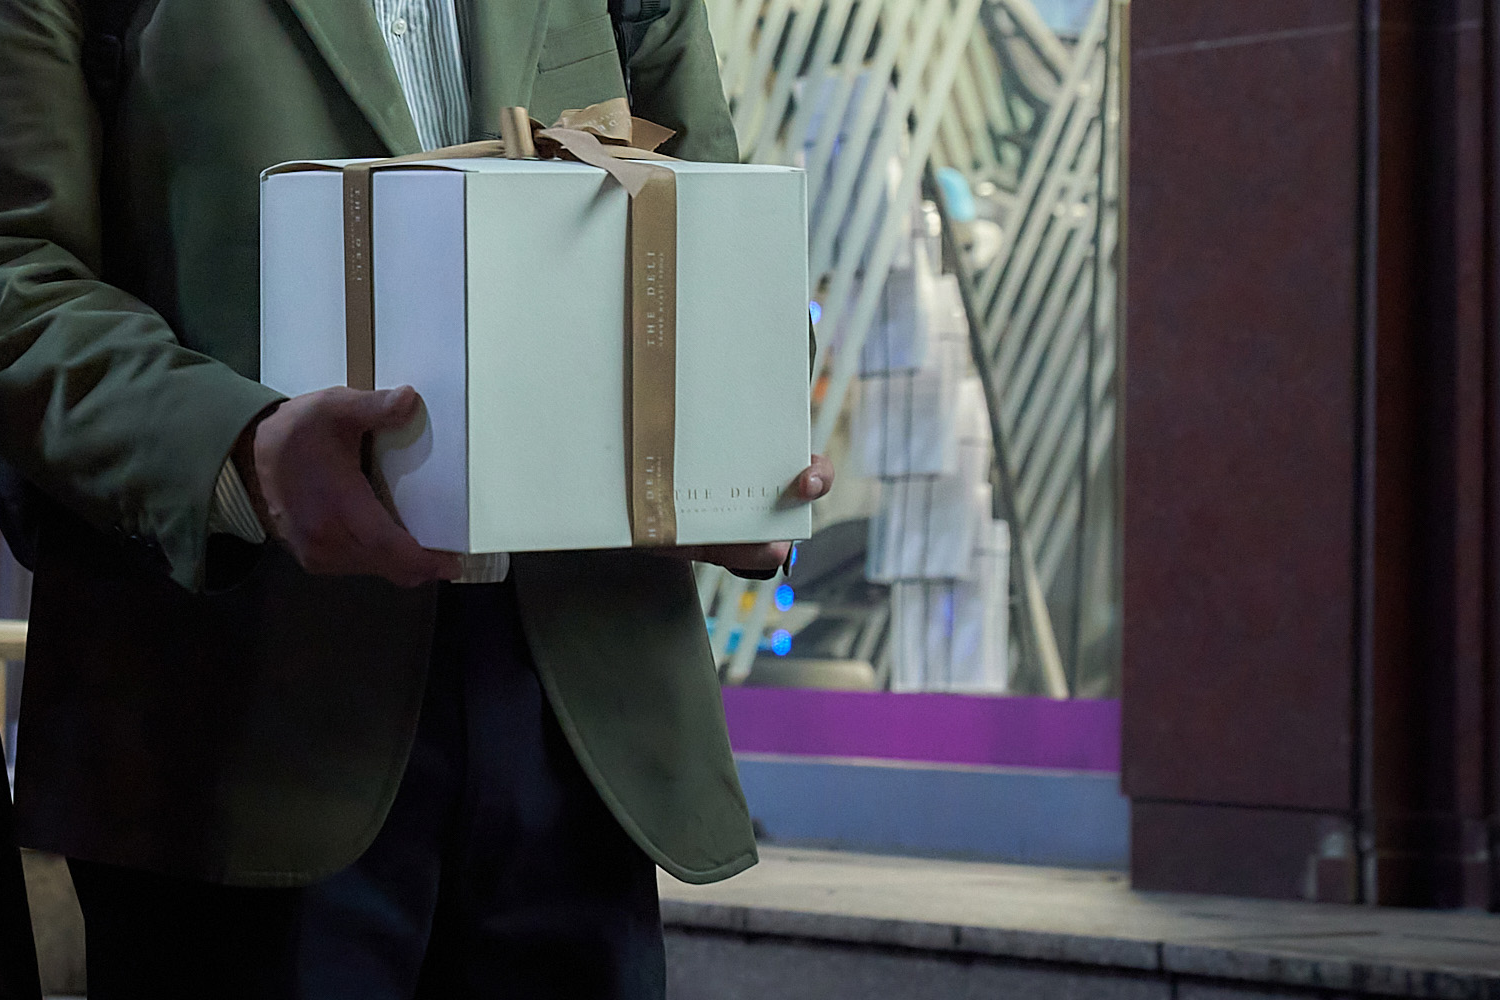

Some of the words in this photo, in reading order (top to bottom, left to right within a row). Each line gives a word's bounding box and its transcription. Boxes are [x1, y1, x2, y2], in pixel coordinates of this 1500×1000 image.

[646, 251, 656, 296] DELI
[646, 311, 656, 348] THE
[645, 455, 655, 500] DELI
